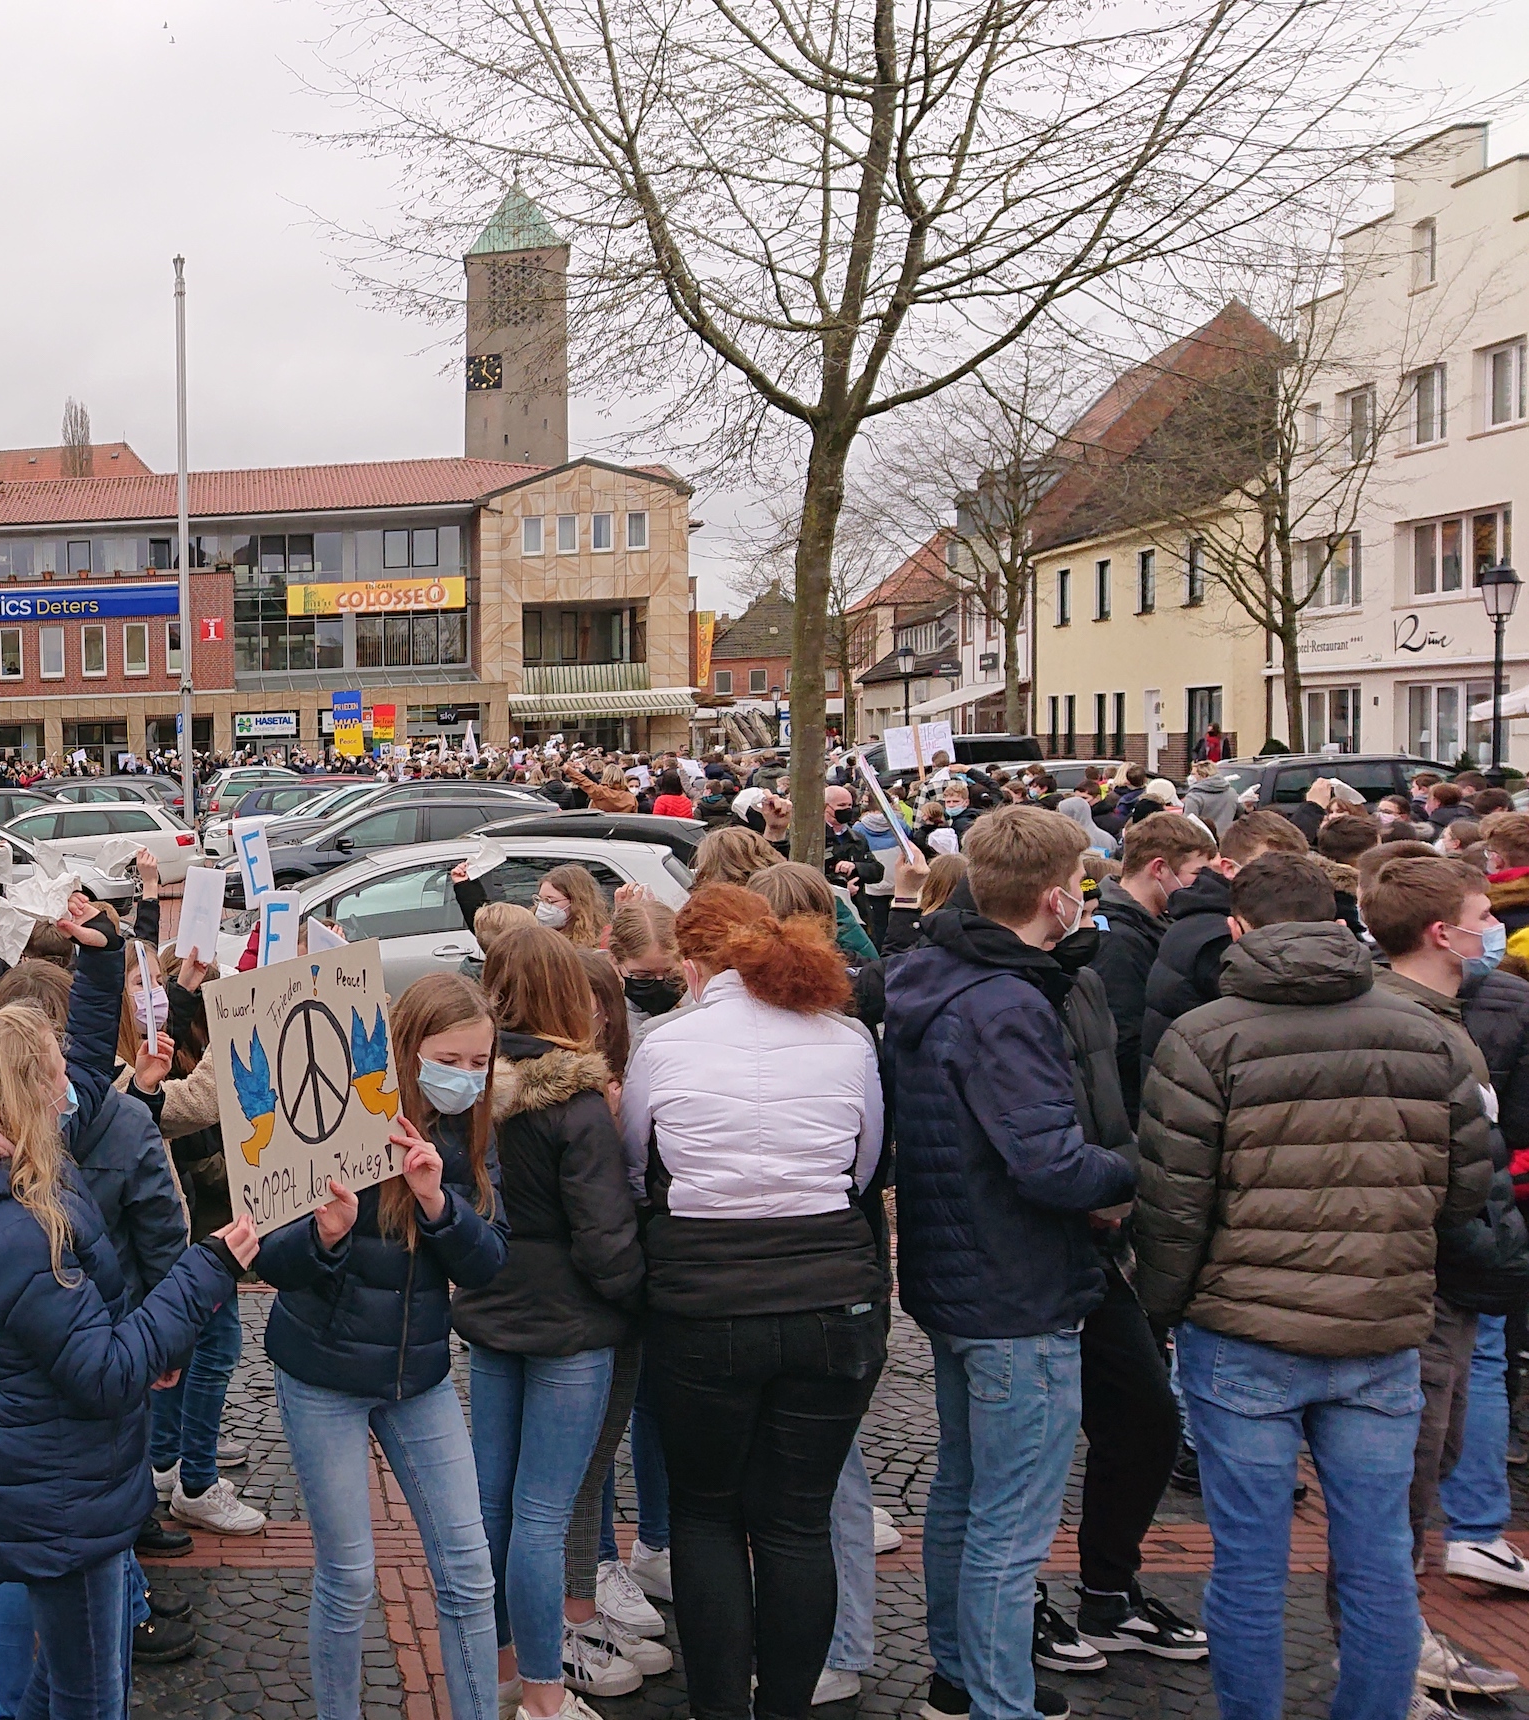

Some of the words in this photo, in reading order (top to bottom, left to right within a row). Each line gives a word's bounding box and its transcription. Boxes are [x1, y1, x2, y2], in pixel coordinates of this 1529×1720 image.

[335, 584, 447, 610] COLOSSEO
[36, 599, 99, 615] Deters
[1297, 640, 1349, 654] otel-Restaurant
[334, 703, 359, 711] FRIEDEN
[255, 716, 294, 726] HASETAL
[439, 713, 456, 722] sky
[905, 724, 947, 743] KIEG
[241, 829, 269, 896] E
[216, 997, 230, 1020] No
[232, 987, 257, 1019] war!
[266, 976, 302, 1028] Frieden
[334, 1143, 394, 1181] Krieg!
